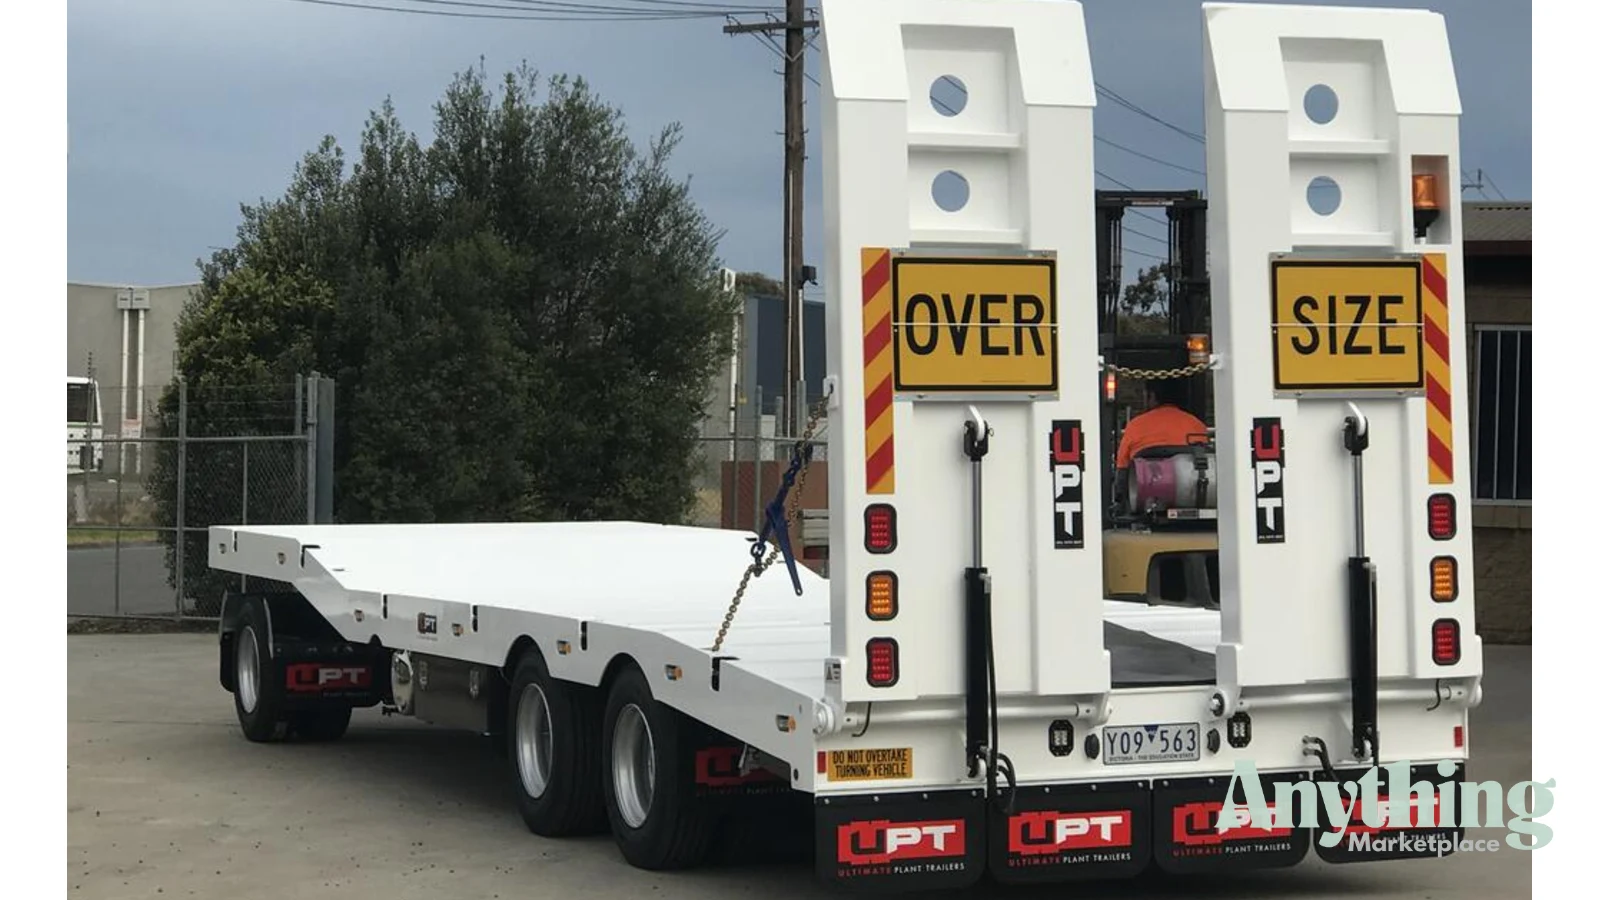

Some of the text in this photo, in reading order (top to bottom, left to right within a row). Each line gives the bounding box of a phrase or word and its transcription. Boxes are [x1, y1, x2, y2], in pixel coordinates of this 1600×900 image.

[905, 293, 1045, 356] OVER
[1291, 295, 1405, 355] SIZE
[1053, 427, 1082, 537] UPT
[1255, 425, 1282, 532] UPT
[295, 667, 366, 685] UPT
[833, 748, 908, 764] DO NOT OVERTAKE
[1106, 728, 1196, 756] Y09 563
[835, 762, 908, 777] TURNING VEHICLE
[850, 825, 957, 855] UPT
[1021, 816, 1123, 845] UPT
[1008, 852, 1131, 867] ULTIMATE PLANT TRAILERS
[1225, 846, 1252, 854] PLANT
[1254, 843, 1291, 852] TRAILERS
[838, 862, 965, 877] ULTIMATE PLANT TRAILERS
